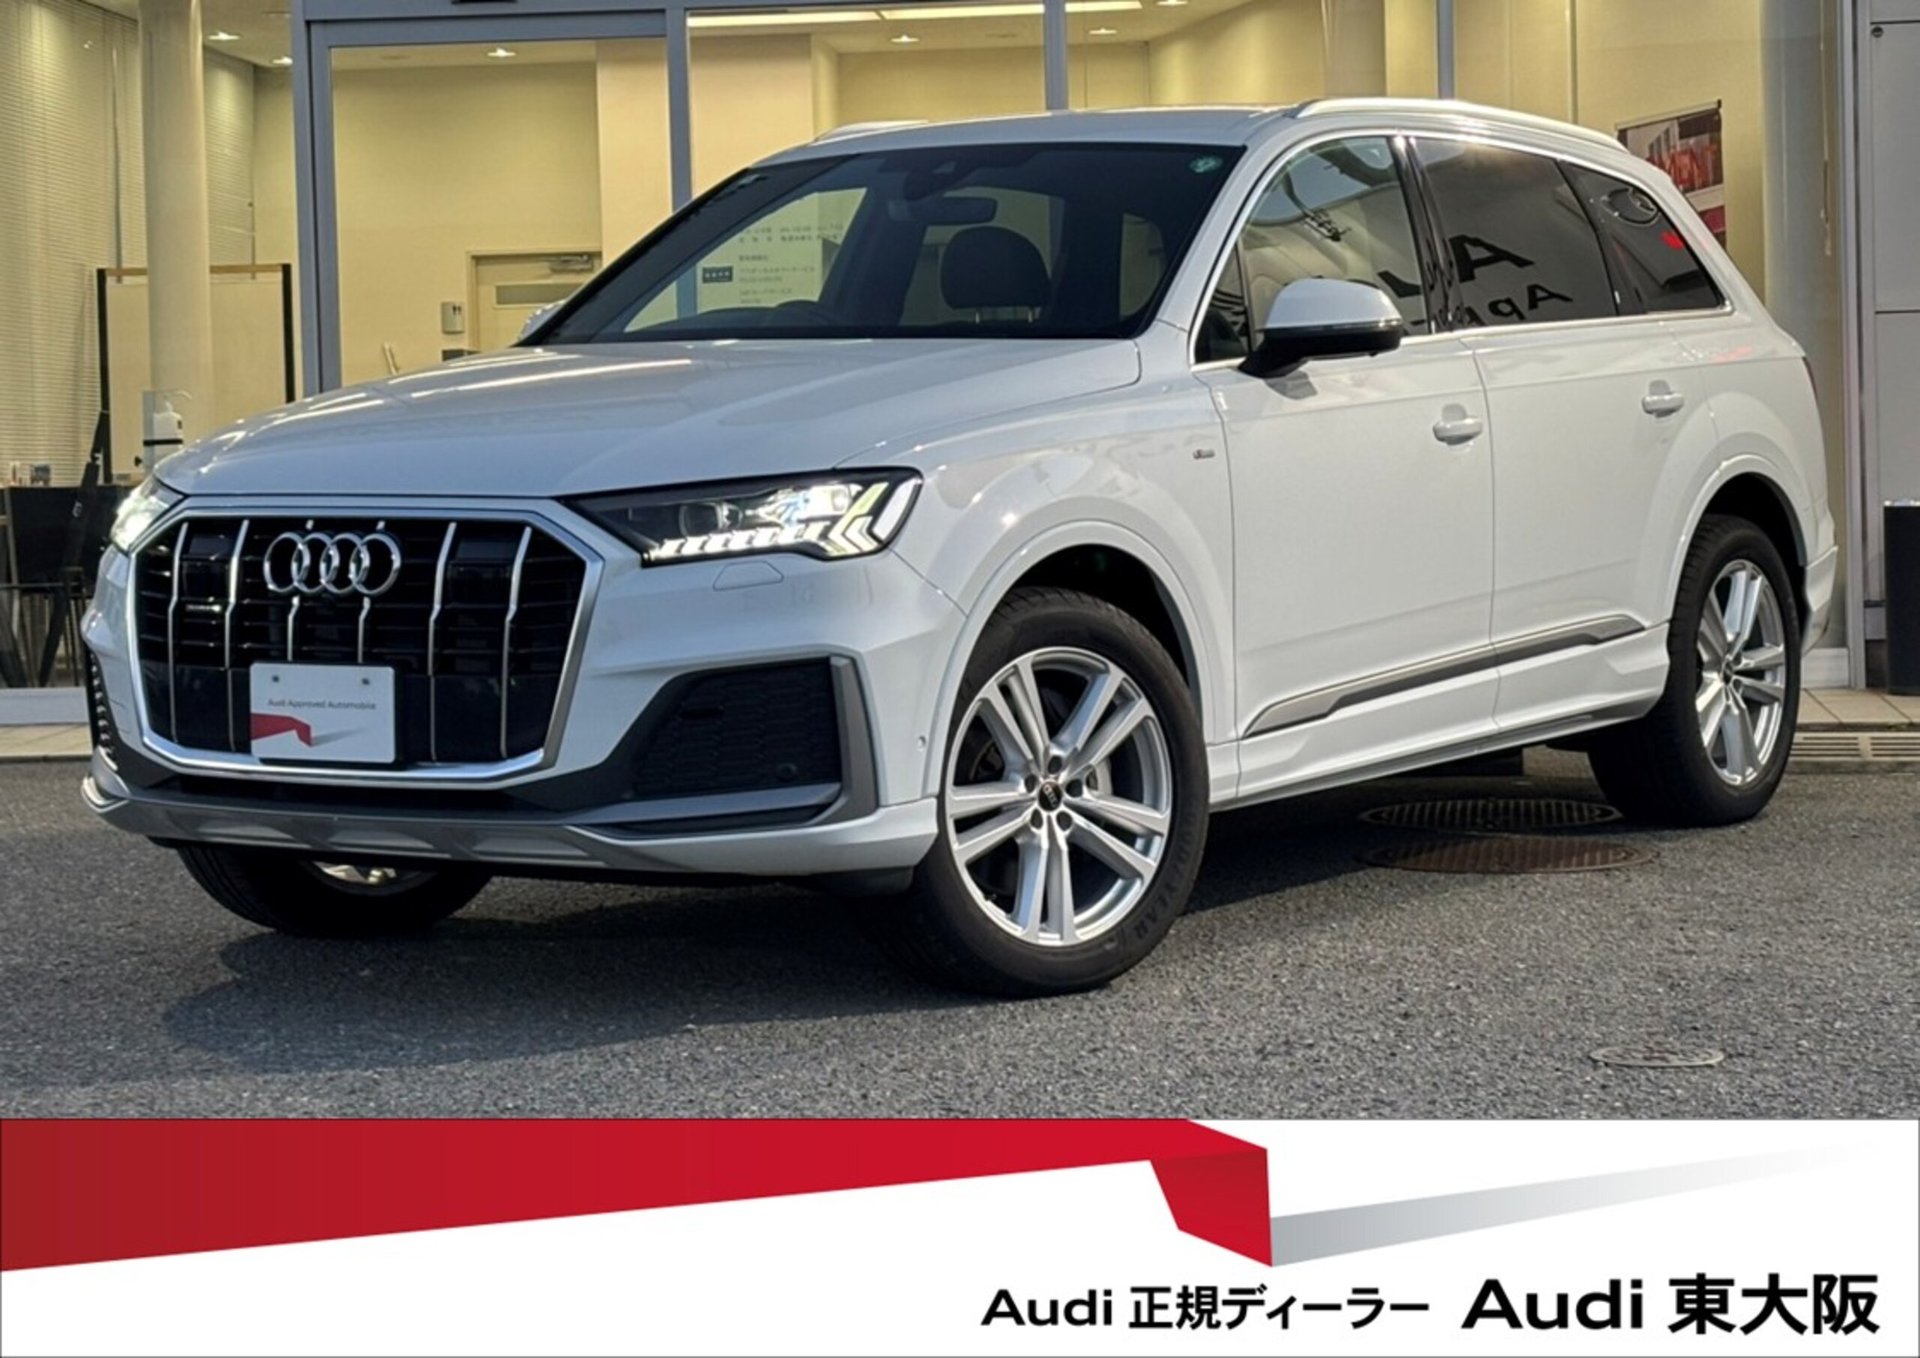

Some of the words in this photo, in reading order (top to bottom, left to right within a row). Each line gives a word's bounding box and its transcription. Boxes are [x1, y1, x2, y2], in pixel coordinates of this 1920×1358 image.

[267, 698, 286, 707] Audi
[287, 699, 326, 710] Approved
[328, 700, 376, 710] Automobile
